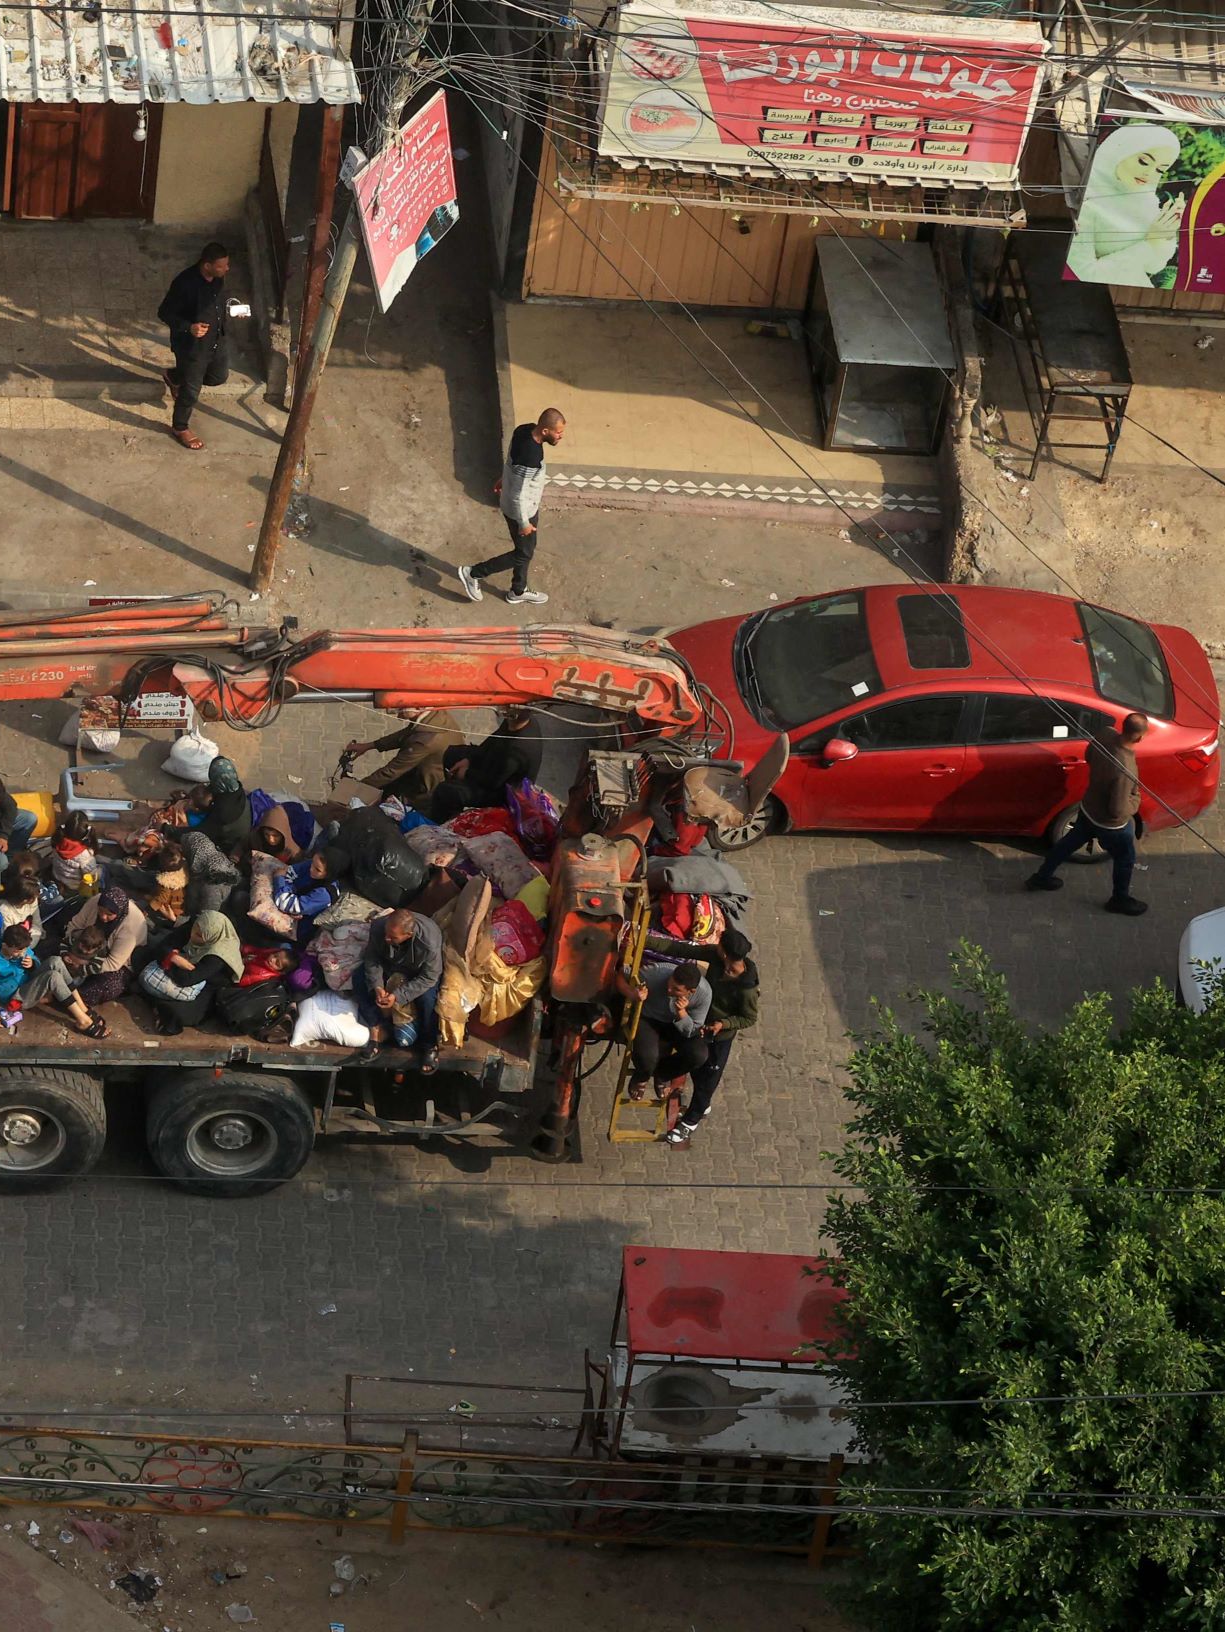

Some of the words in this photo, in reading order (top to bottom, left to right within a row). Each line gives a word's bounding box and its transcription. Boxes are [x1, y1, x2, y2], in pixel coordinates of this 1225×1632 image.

[871, 42, 1018, 100] حلويات
[931, 123, 965, 132] كنافة
[32, 671, 64, 681] F230
